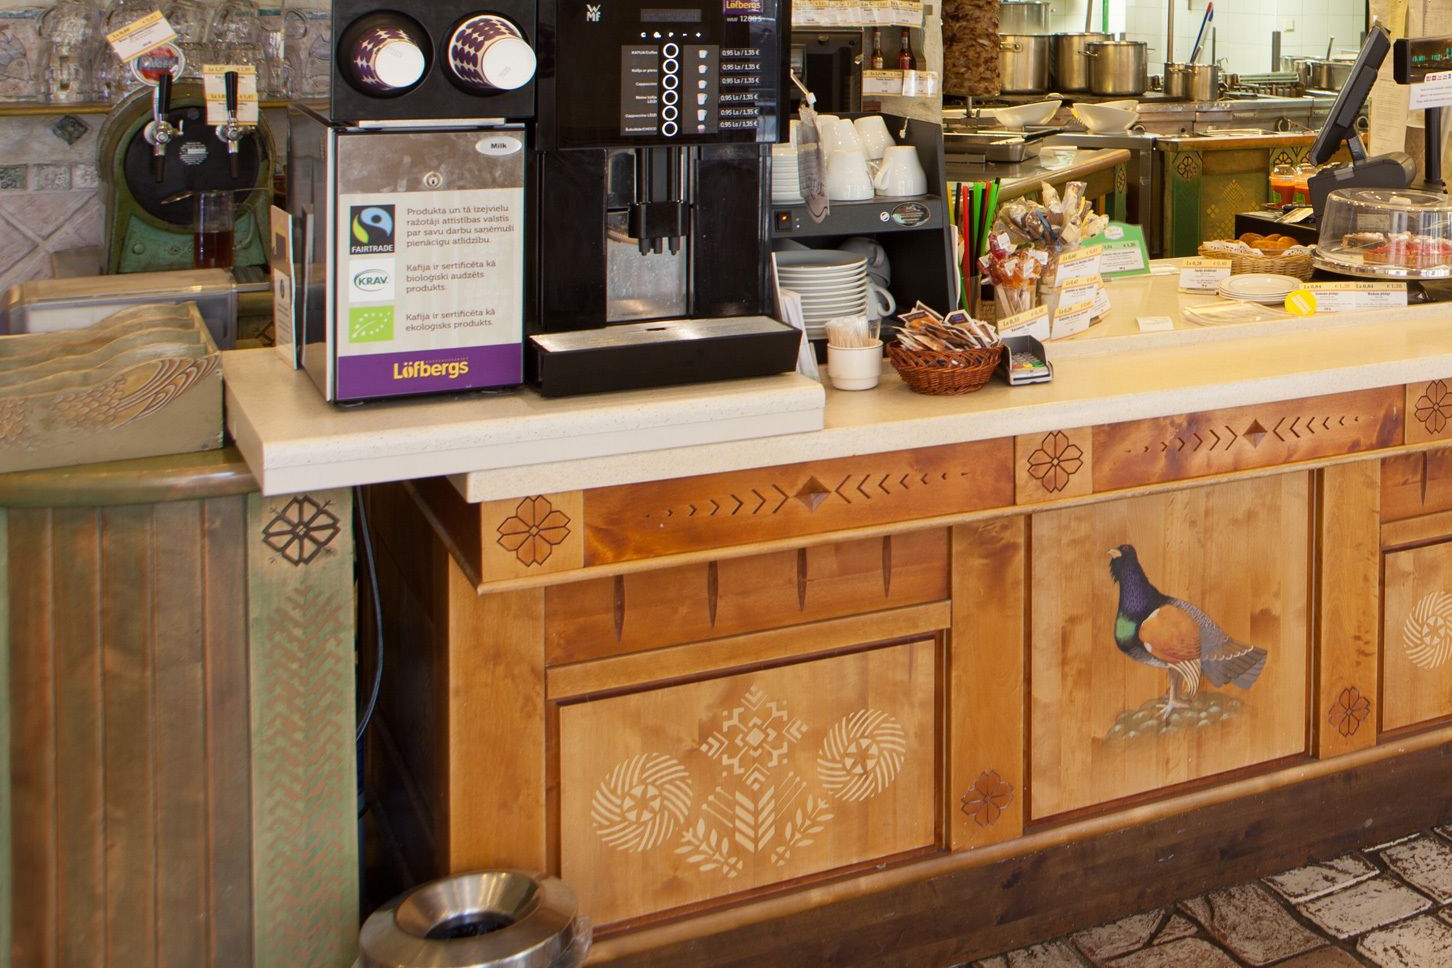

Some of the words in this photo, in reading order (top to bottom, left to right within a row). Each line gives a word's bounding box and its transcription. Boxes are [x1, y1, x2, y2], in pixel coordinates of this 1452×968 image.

[726, 0, 761, 11] Löfbergs
[586, 3, 601, 23] WMF
[406, 207, 447, 215] Produkta
[473, 204, 509, 215] izejvielu
[406, 218, 440, 227] ražotāji
[406, 230, 421, 238] par
[446, 227, 472, 235] darbu
[351, 244, 394, 254] FAIRTRADE
[406, 263, 431, 273] Kafija
[441, 261, 485, 270] sertificēta
[486, 260, 496, 268] kā
[358, 275, 388, 286] KRAV
[450, 271, 485, 279] audzēts
[405, 284, 447, 294] produkts.
[405, 312, 431, 322] Kafija
[440, 310, 484, 319] sertificēta
[485, 308, 496, 317] kā
[453, 320, 493, 330] produkts.
[393, 360, 469, 380] Löfbergs
